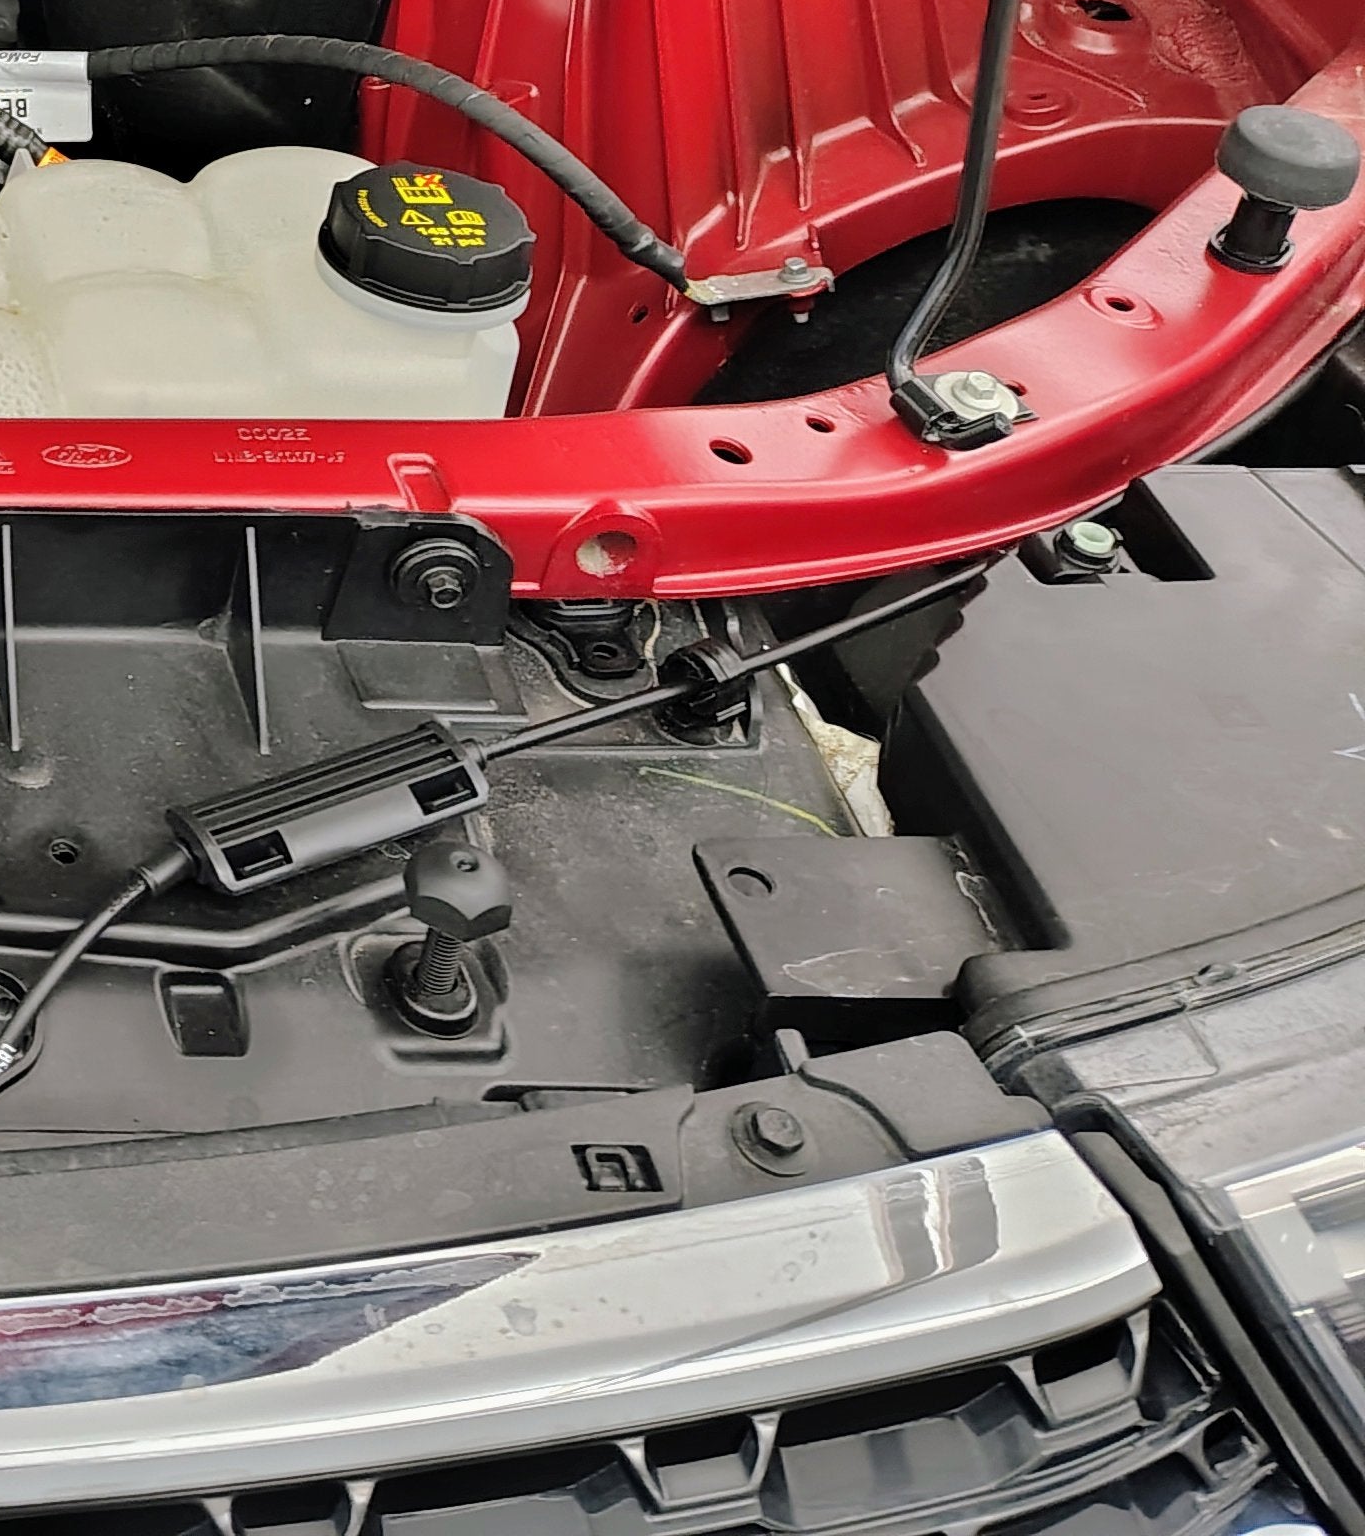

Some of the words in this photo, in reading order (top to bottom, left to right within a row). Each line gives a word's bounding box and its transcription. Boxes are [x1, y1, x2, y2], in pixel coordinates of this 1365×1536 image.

[417, 227, 449, 236] 145
[450, 227, 486, 236] kPa
[430, 237, 454, 246] 21
[457, 237, 486, 247] psi
